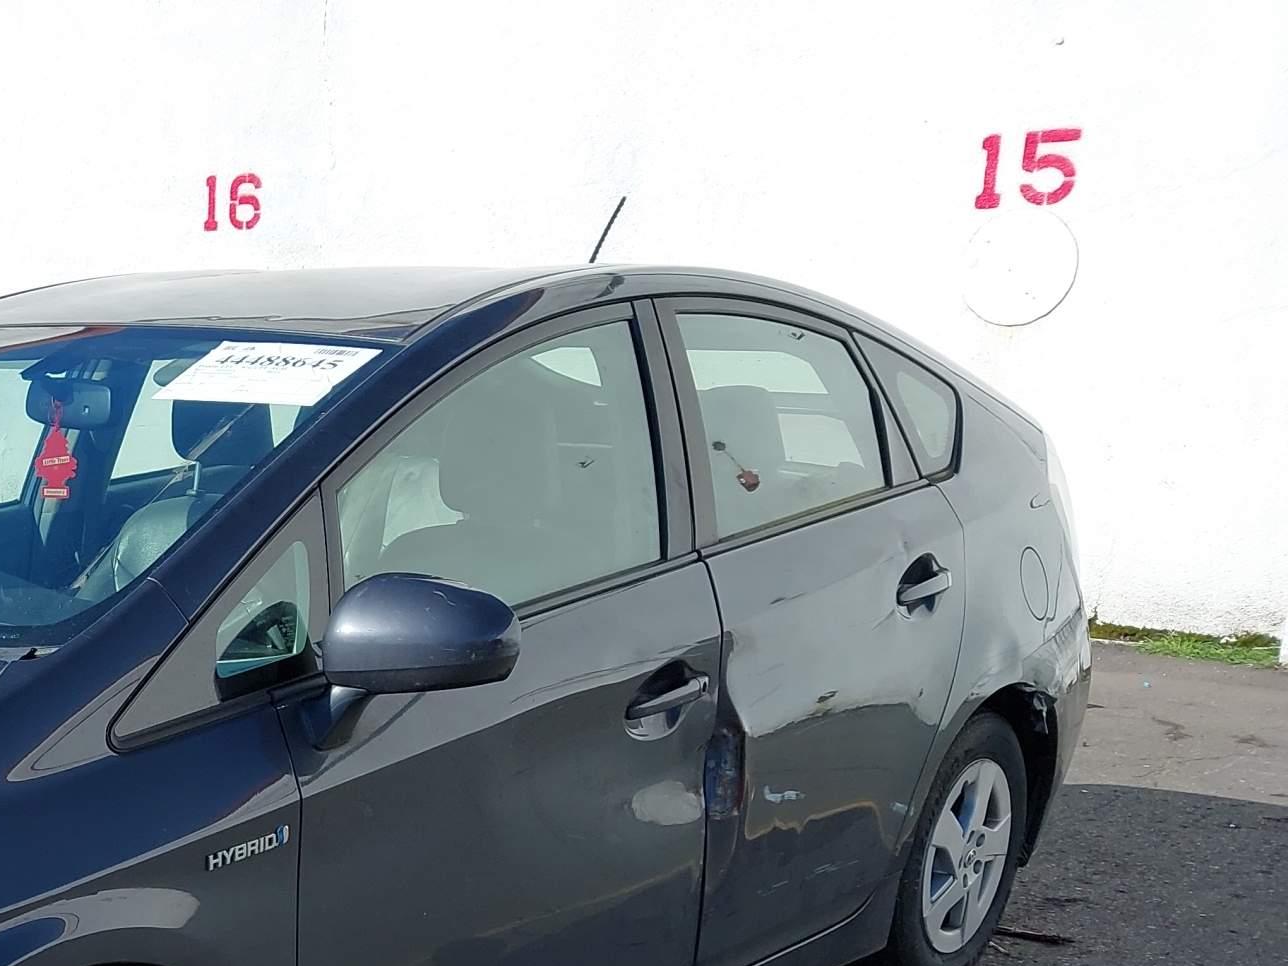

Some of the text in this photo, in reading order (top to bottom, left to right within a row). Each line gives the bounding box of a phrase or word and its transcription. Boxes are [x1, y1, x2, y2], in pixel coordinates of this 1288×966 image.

[973, 127, 1083, 211] 15
[203, 172, 263, 233] 16
[215, 353, 344, 371] 44488645
[207, 832, 279, 871] HYBRID
